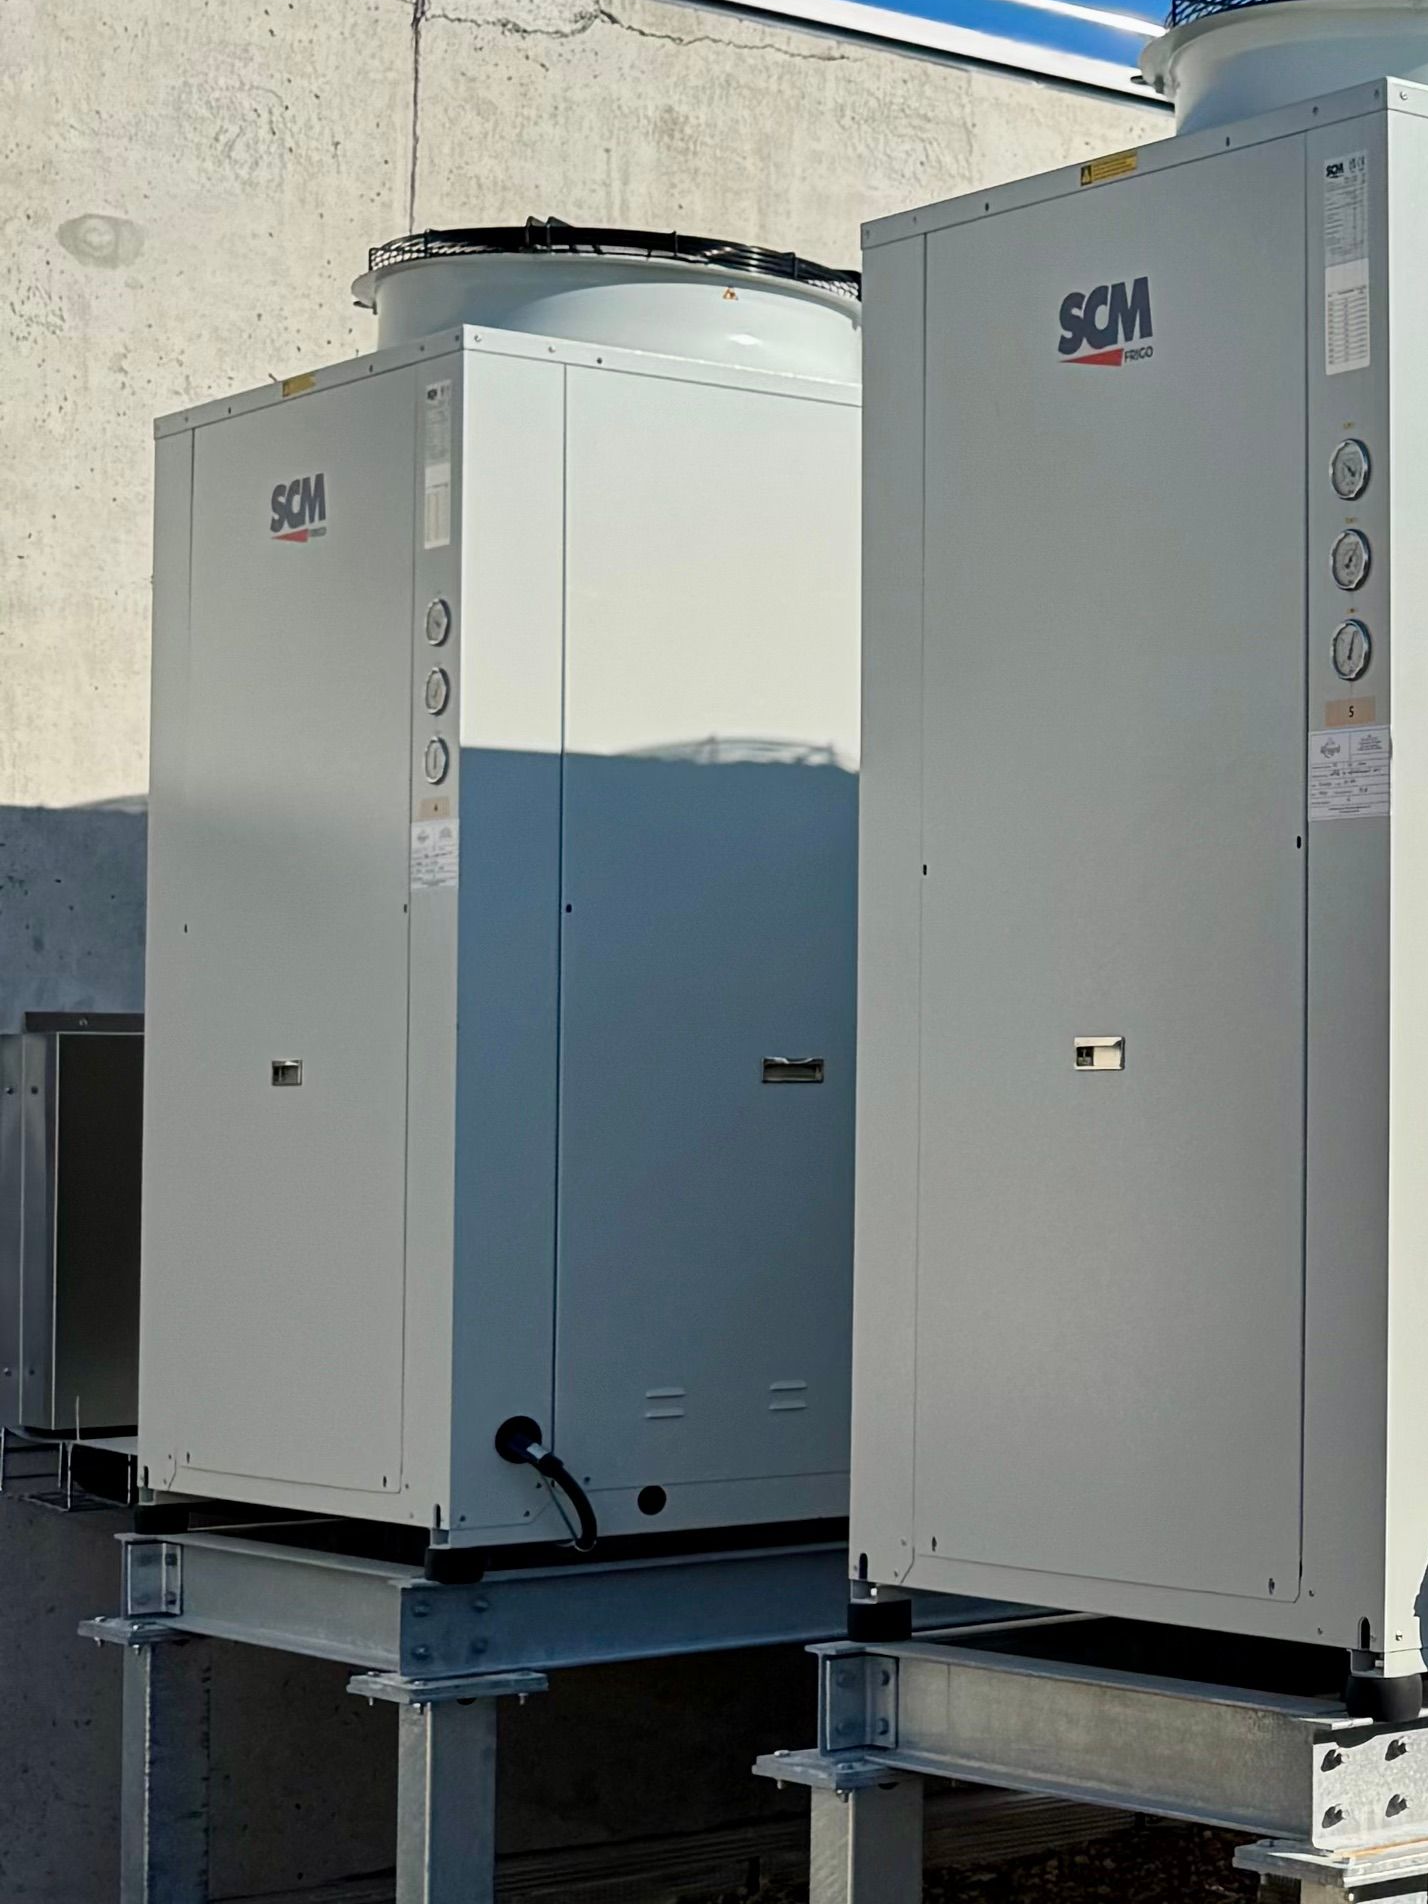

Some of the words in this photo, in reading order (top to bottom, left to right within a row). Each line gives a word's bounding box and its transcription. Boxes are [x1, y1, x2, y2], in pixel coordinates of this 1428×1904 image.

[1058, 276, 1153, 355] SCM
[1124, 346, 1154, 363] FRIGO
[270, 473, 327, 533] SCM
